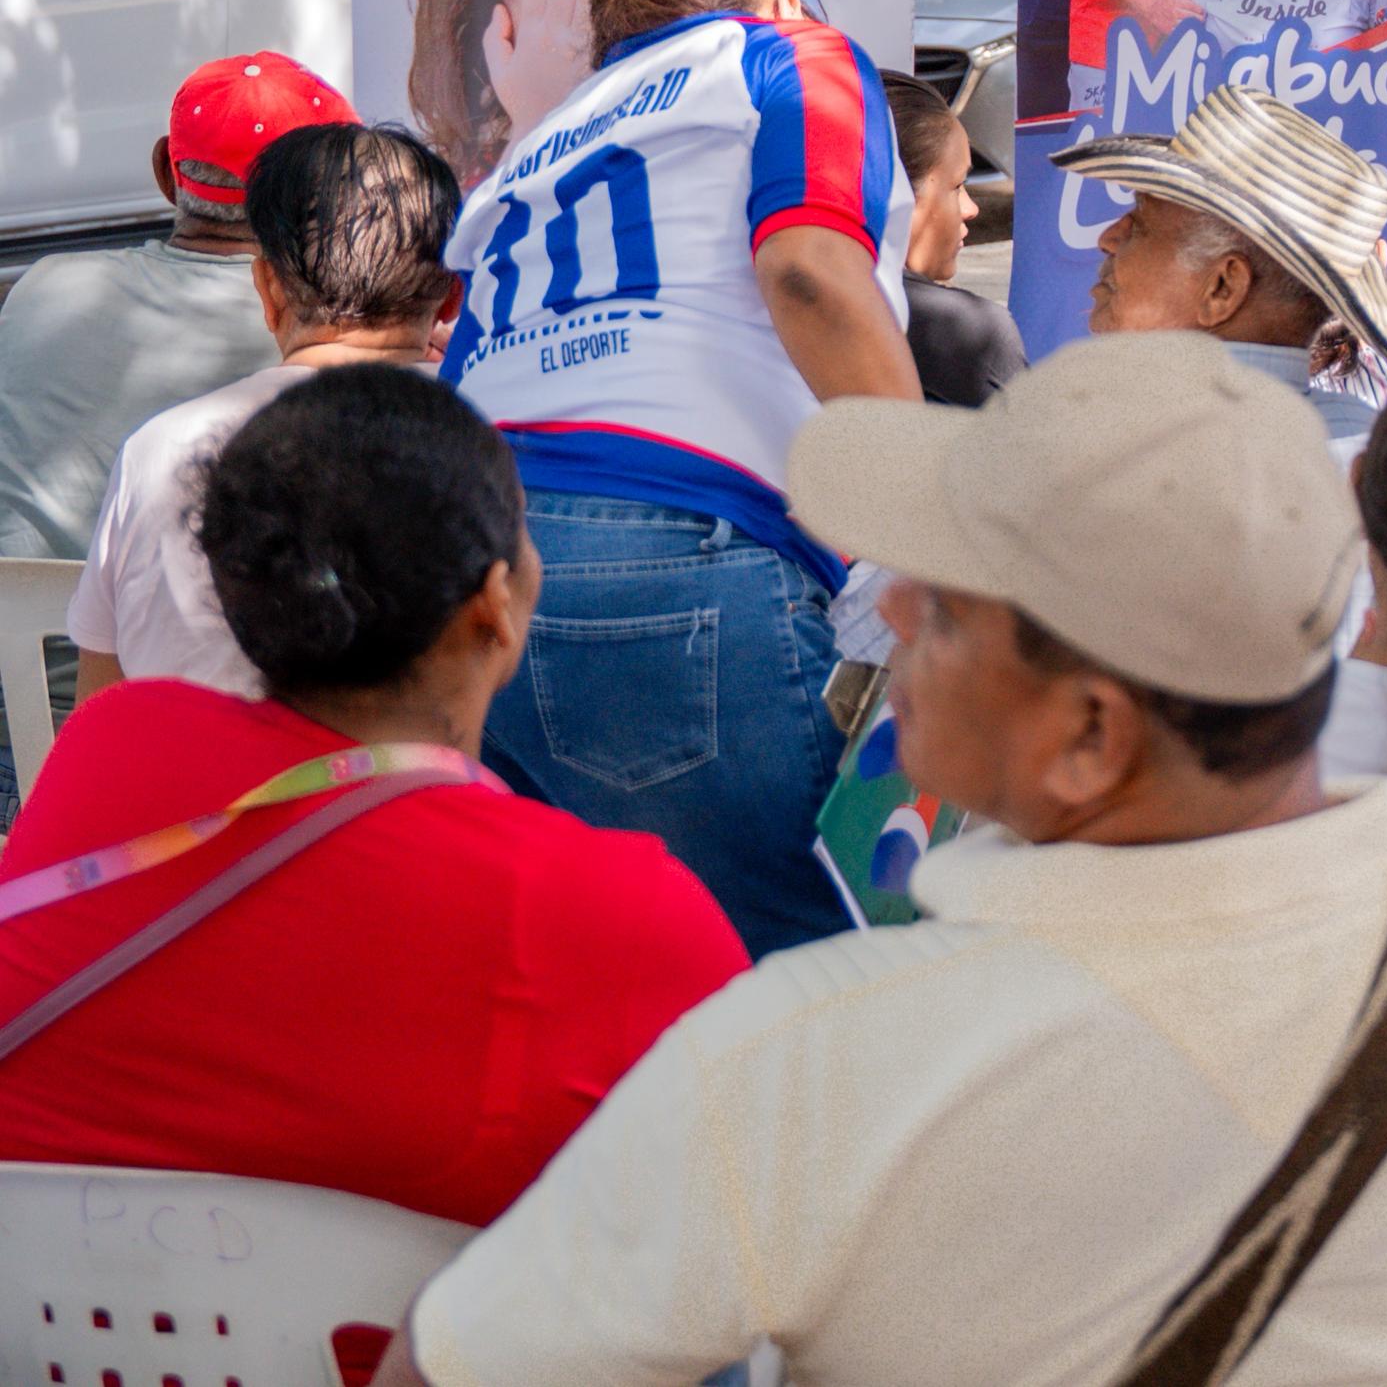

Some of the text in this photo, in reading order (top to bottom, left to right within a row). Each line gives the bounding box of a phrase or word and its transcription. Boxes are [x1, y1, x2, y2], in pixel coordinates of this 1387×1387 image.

[1112, 28, 1210, 133] Mi
[540, 347, 559, 373] EL
[561, 328, 631, 368] DEPORTE
